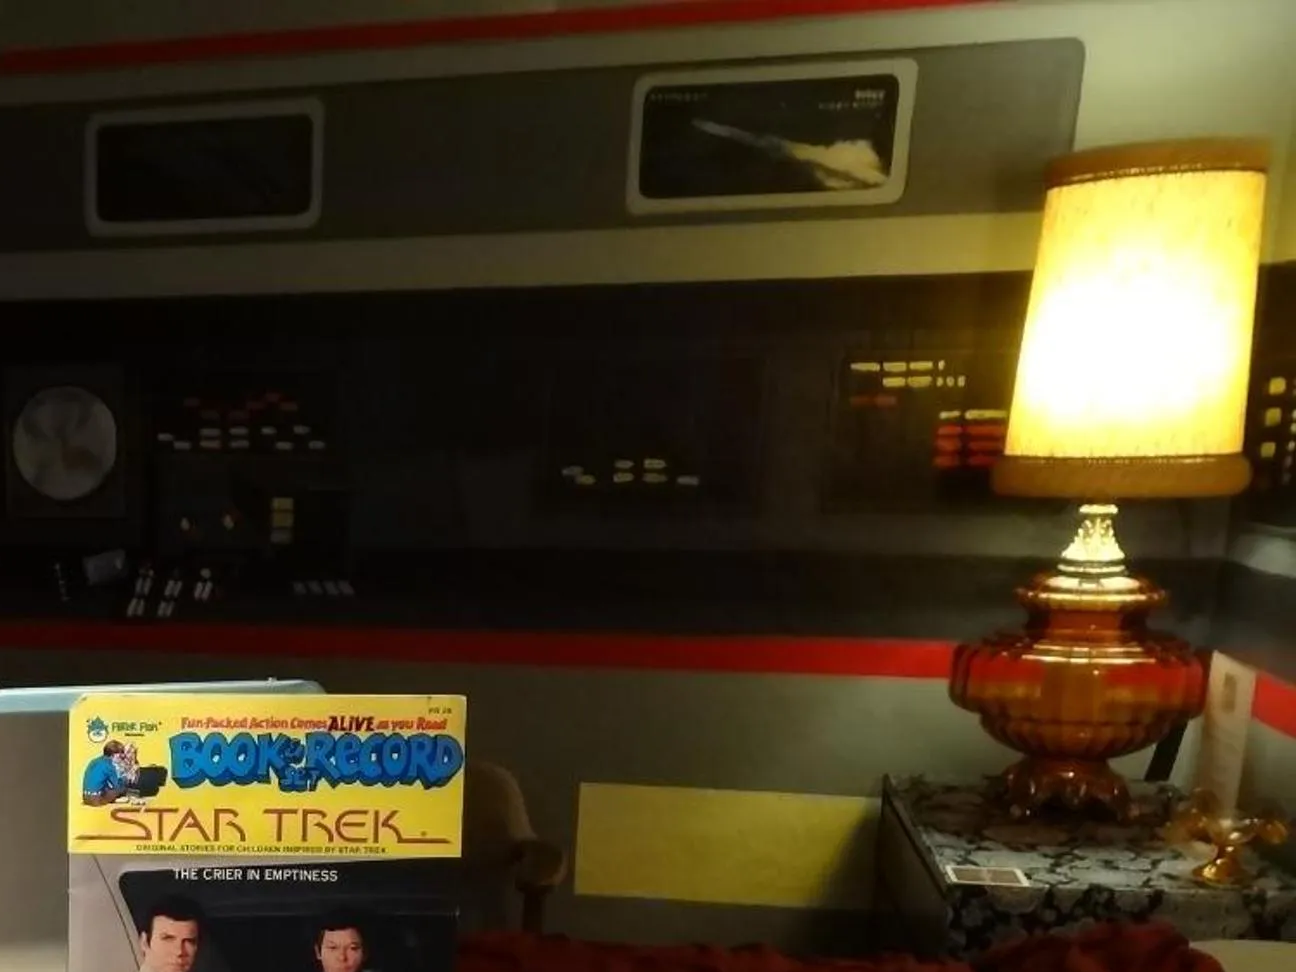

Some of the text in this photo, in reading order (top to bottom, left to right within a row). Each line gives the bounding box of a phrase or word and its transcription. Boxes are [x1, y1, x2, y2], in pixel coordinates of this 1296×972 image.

[249, 716, 288, 730] Action
[290, 717, 326, 730] Comes
[391, 719, 413, 731] you
[416, 717, 447, 730] Read
[169, 732, 289, 789] BOOK
[306, 731, 464, 789] RECORD
[75, 808, 451, 845] STAR TREK
[136, 844, 176, 852] ORIGINAL
[181, 844, 215, 852] STORIES
[217, 844, 234, 852] FOR
[236, 844, 281, 853] CHILDREN
[338, 845, 361, 854] STAR
[173, 868, 339, 882] THE CRIER IN EMPTINESS
